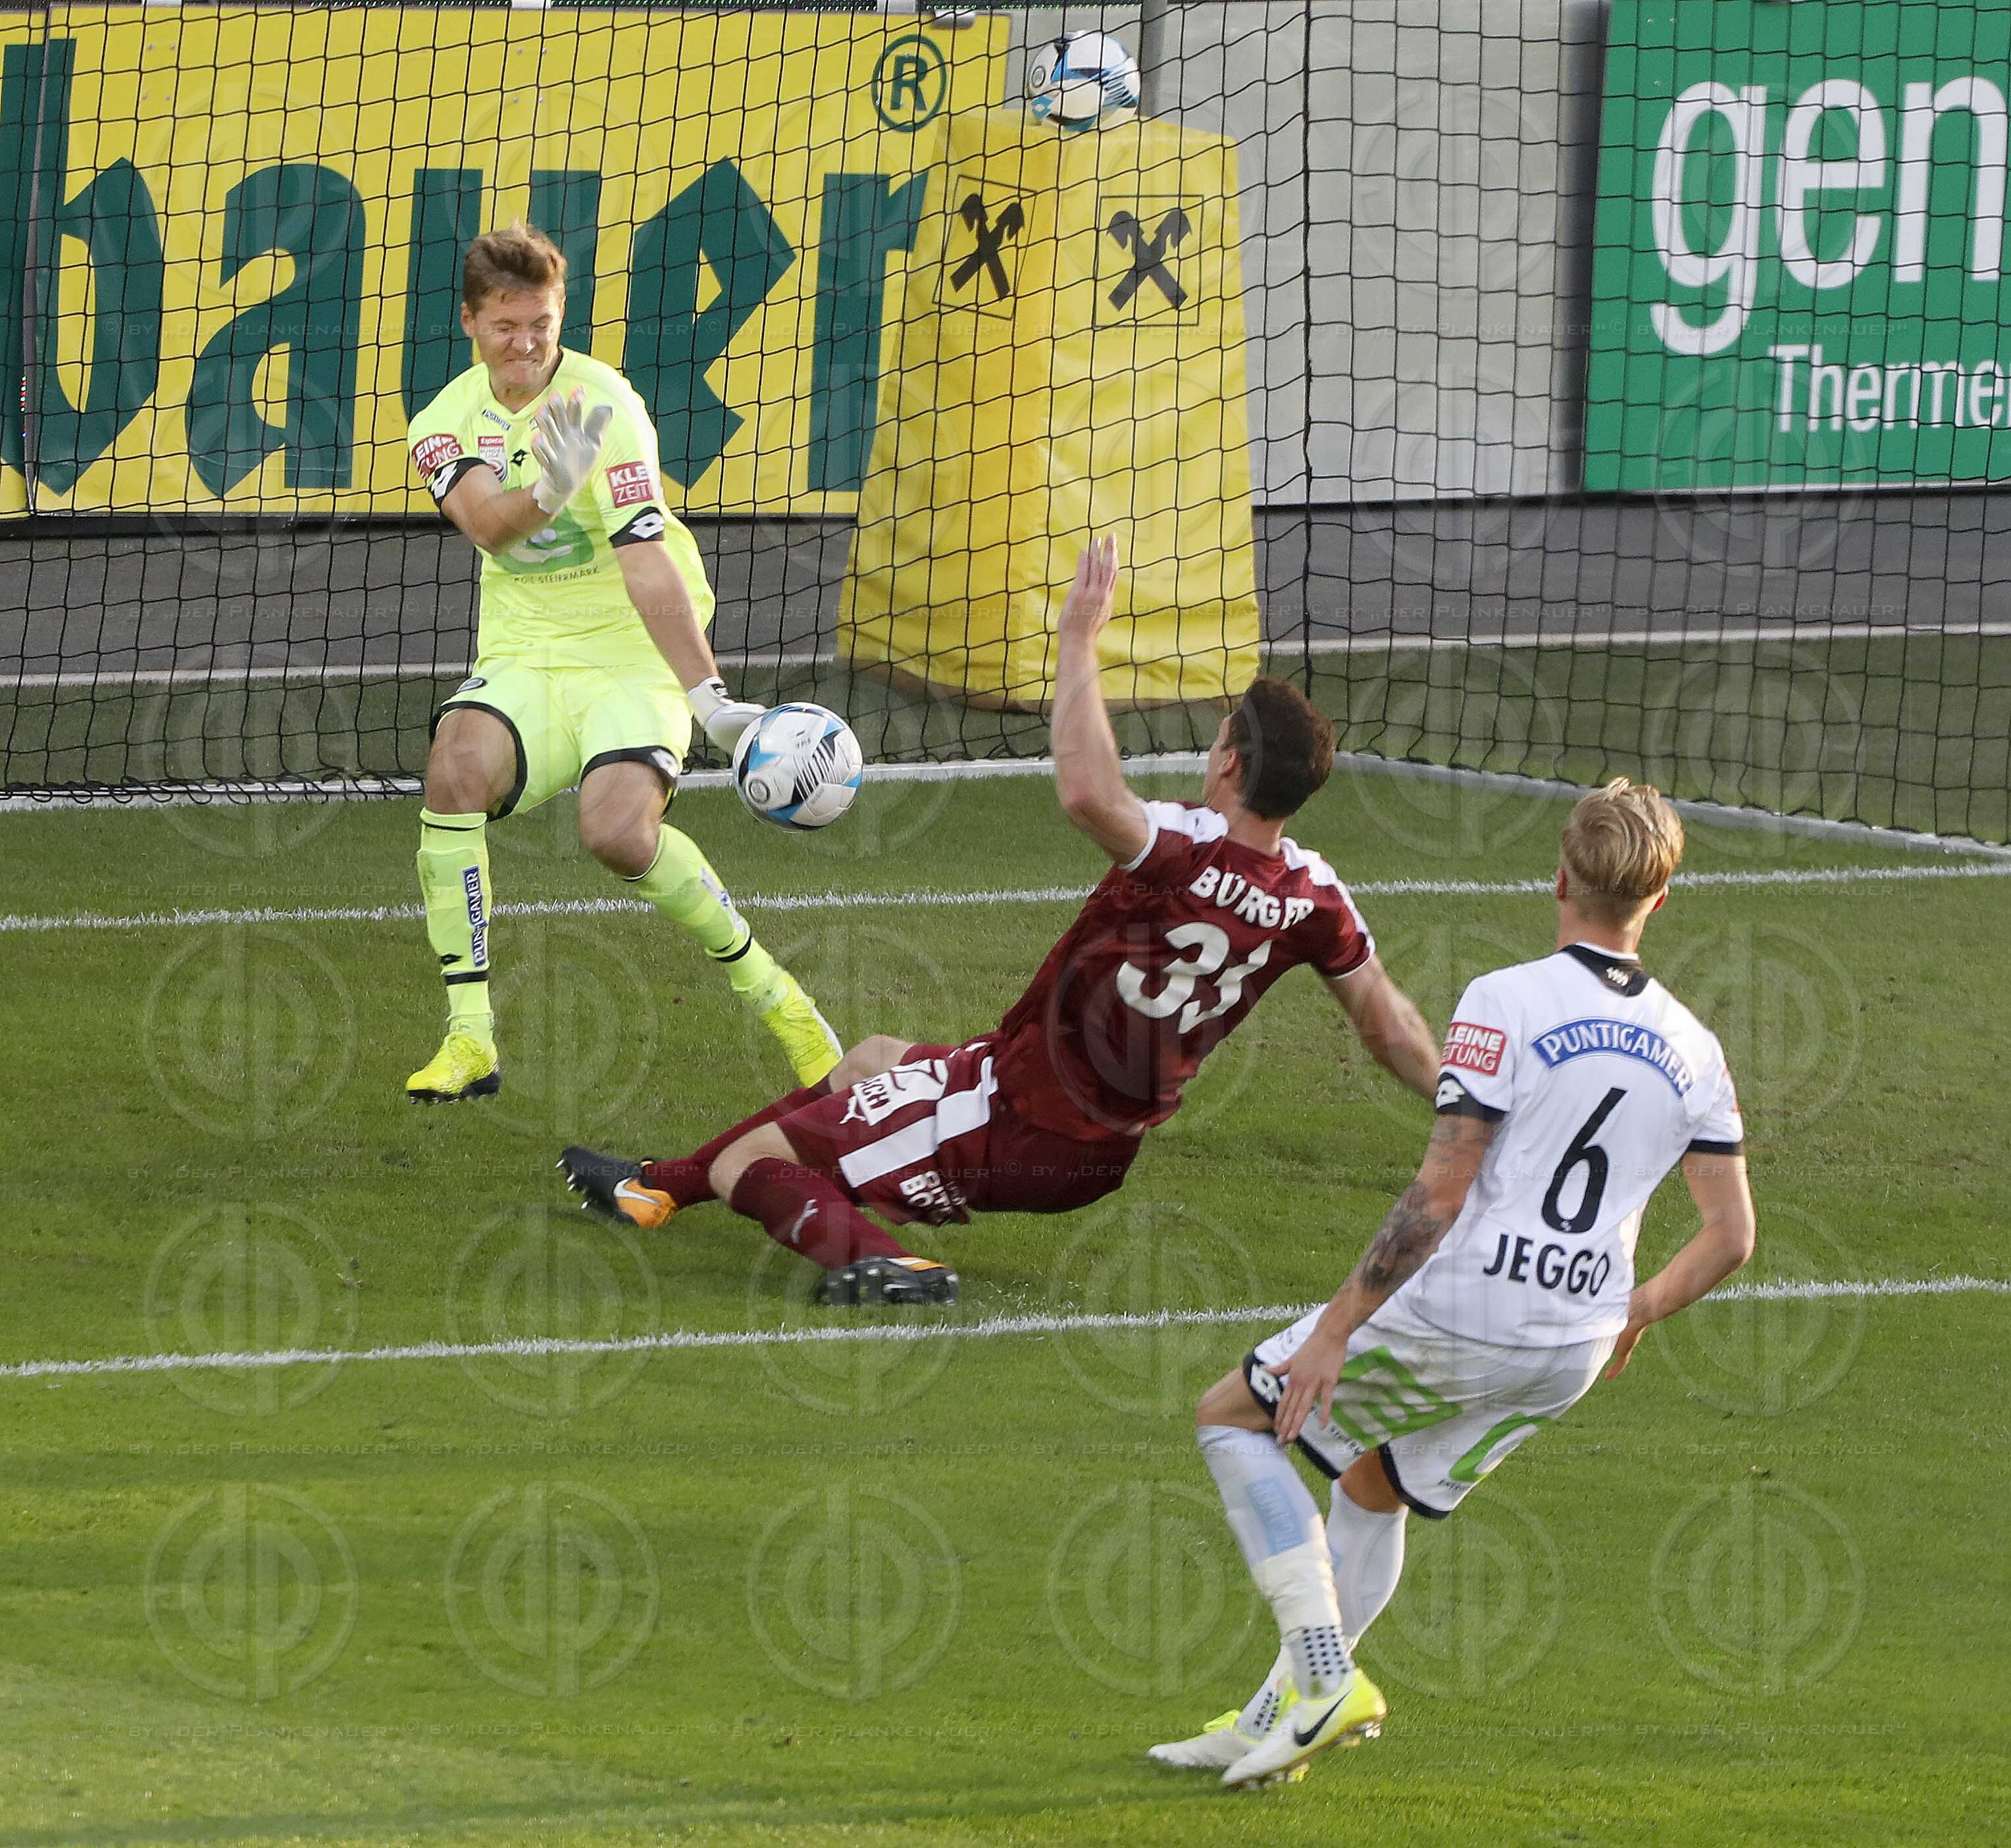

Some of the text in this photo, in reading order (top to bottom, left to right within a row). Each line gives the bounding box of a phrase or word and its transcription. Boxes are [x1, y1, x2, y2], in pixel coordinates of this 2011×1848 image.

[1768, 344, 2011, 432] Therme
[615, 482, 651, 504] ZEIT
[1539, 1023, 1693, 1092] PUNTIGAMER
[1541, 1087, 1629, 1233] 6
[1483, 1233, 1611, 1296] JEGGO
